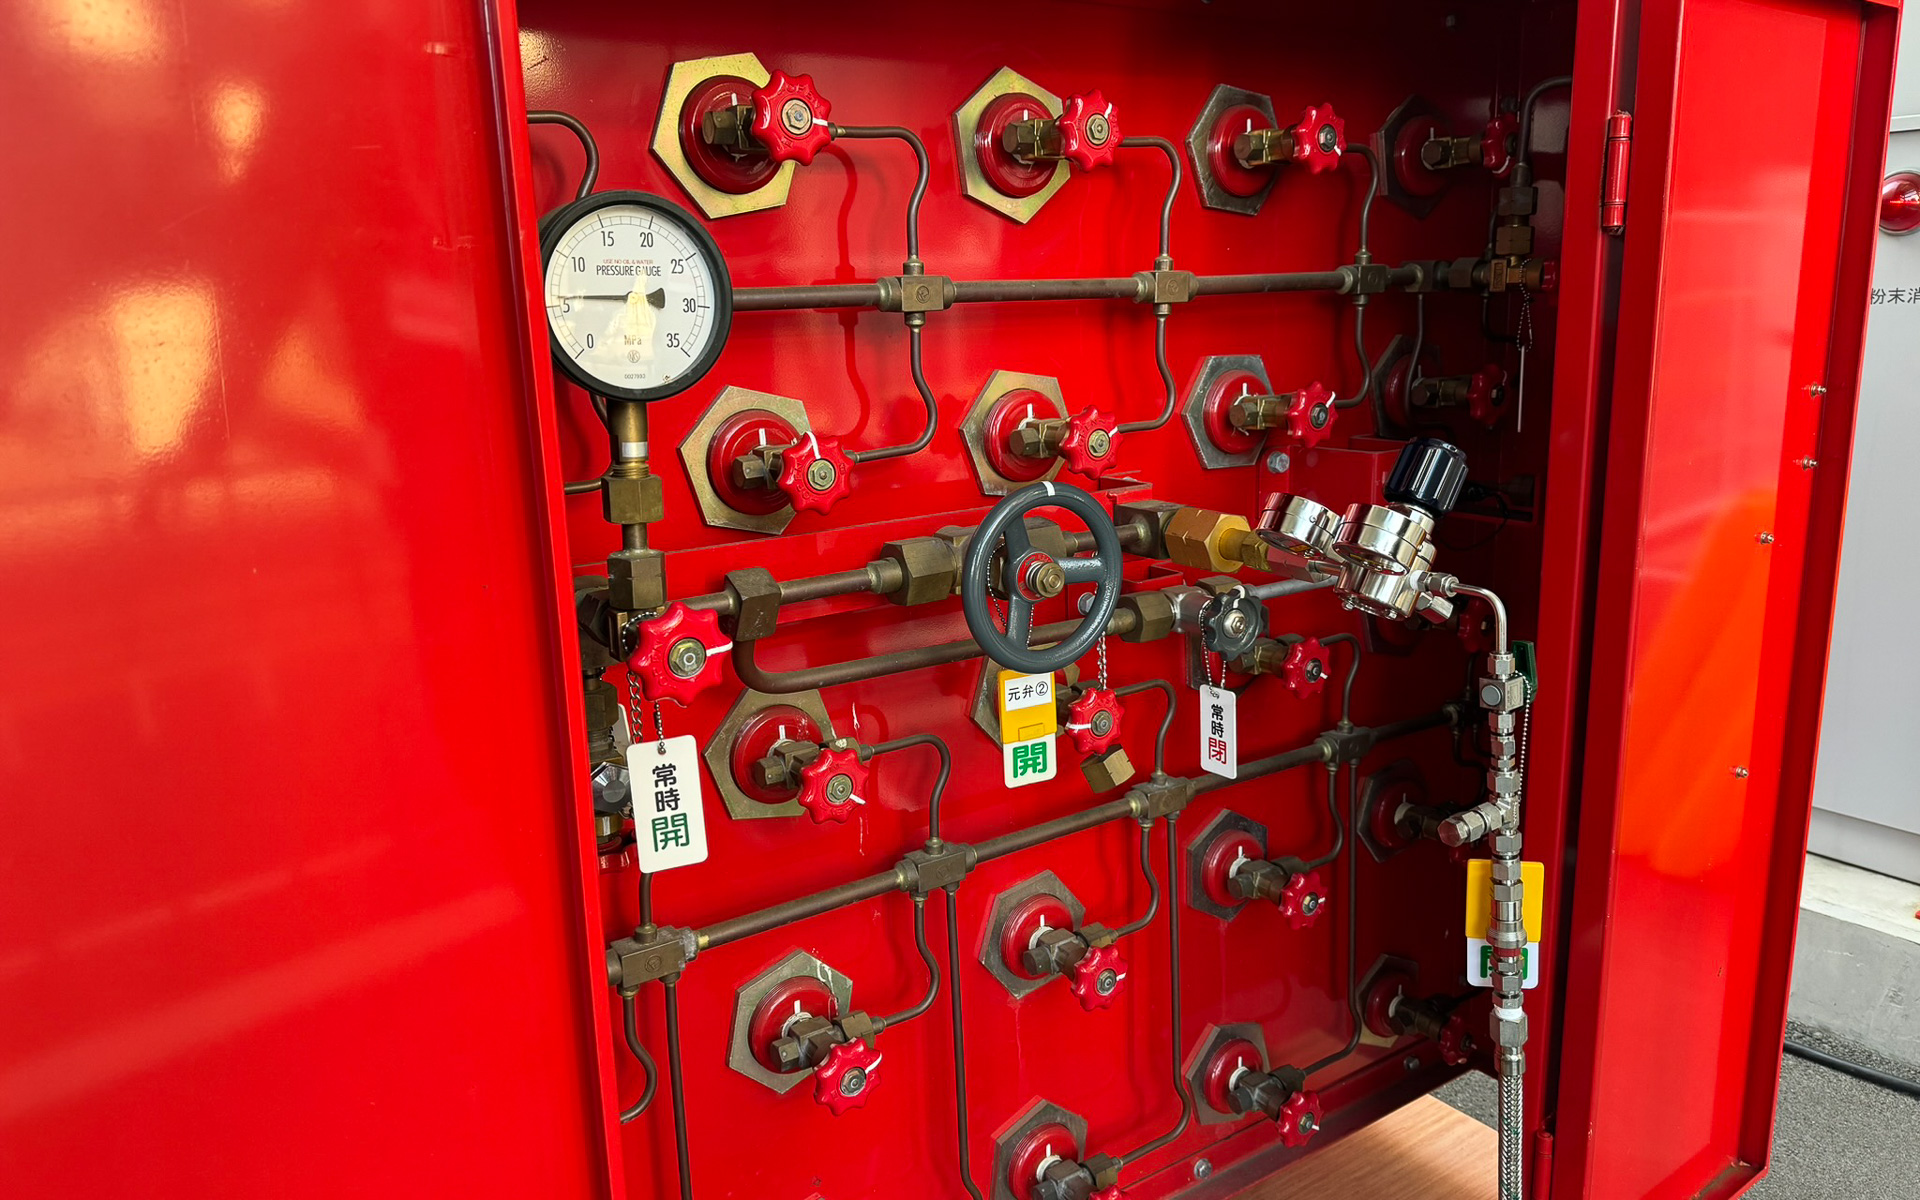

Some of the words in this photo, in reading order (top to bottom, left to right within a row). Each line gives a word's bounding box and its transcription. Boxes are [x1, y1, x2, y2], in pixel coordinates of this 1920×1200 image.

[601, 231, 615, 247] 15
[640, 232, 654, 248] 20
[572, 257, 586, 273] 10
[596, 265, 635, 276] PRESSURE
[671, 259, 685, 274] 25
[563, 300, 570, 313] 5
[682, 298, 696, 313] 30
[586, 333, 594, 349] 0
[624, 335, 642, 345] MPa
[666, 333, 680, 348] 35
[1012, 741, 1048, 778] 開
[652, 763, 690, 853] 常時開
